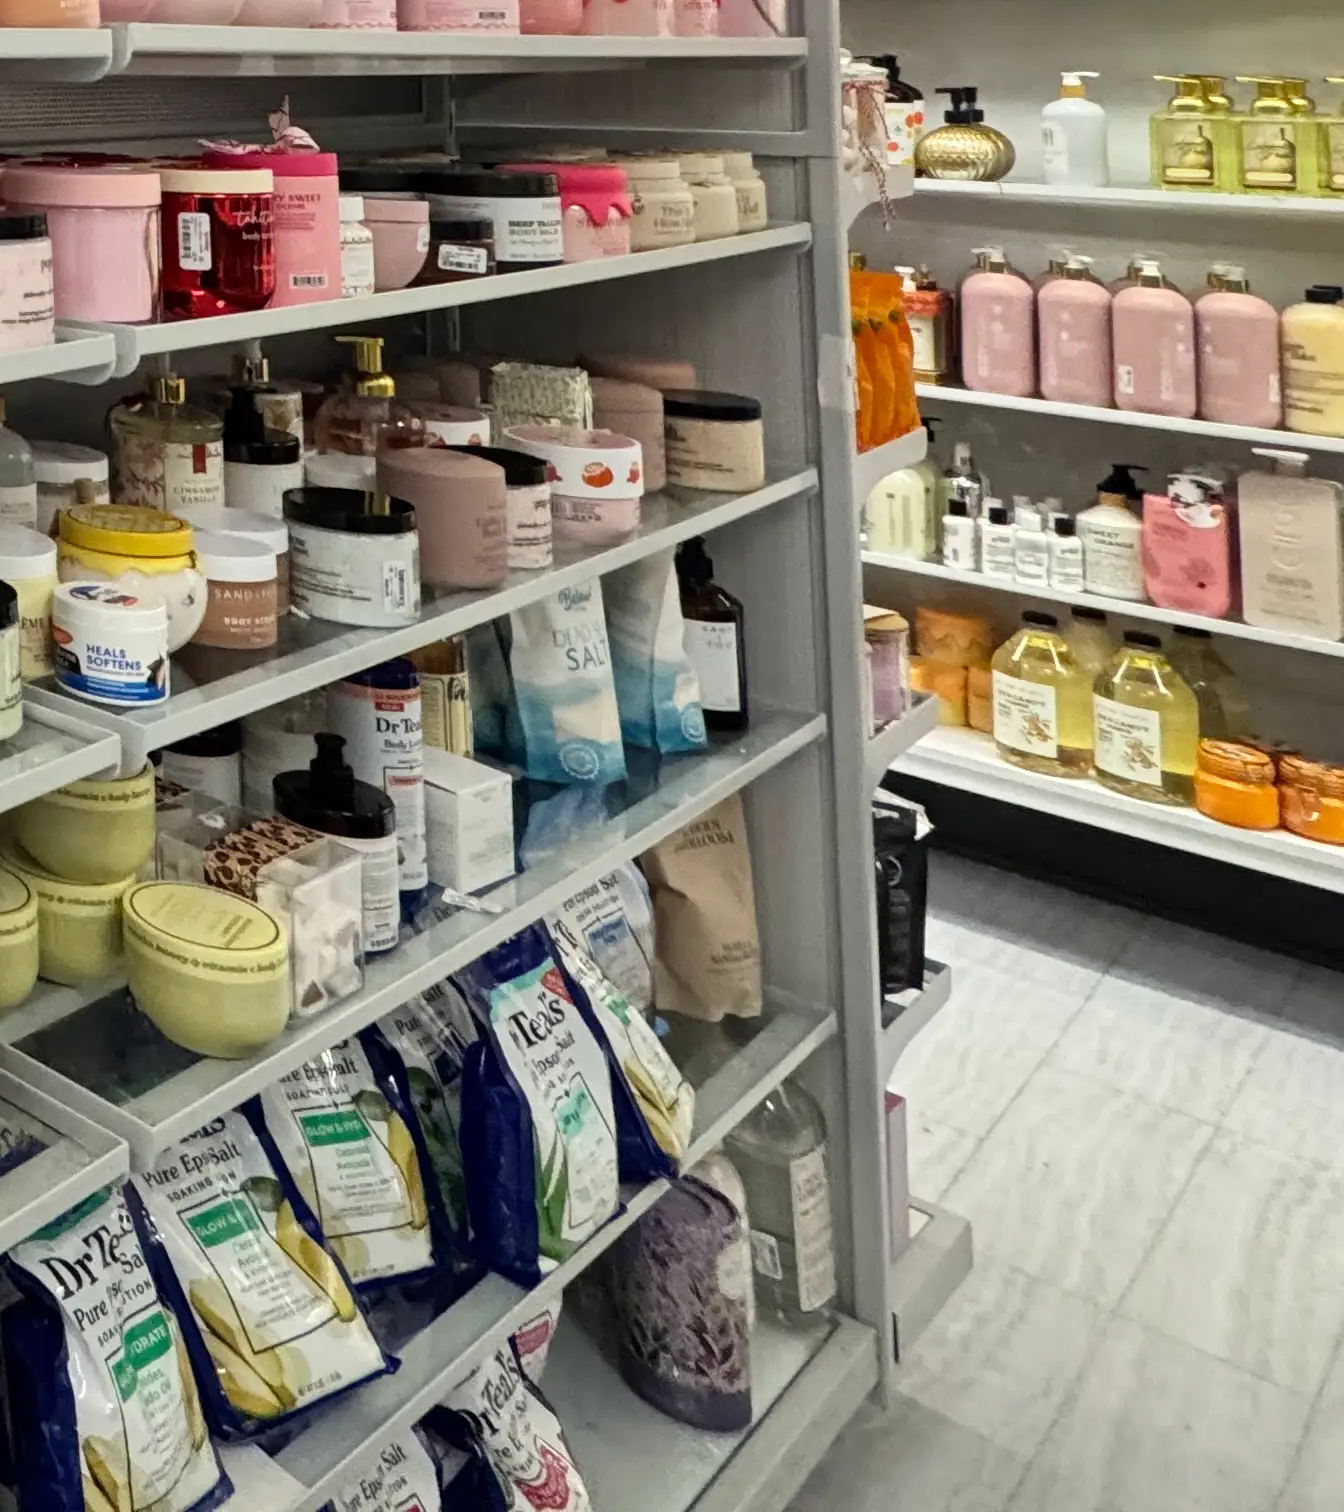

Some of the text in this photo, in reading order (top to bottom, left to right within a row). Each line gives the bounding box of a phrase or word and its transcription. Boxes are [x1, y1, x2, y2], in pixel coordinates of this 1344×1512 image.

[85, 642, 127, 661] HEALS
[85, 654, 143, 673] SOFTENS
[564, 638, 611, 672] SALT
[375, 716, 401, 734] Dr
[141, 1140, 243, 1190] Pure Salt
[72, 1299, 109, 1333] Pure
[378, 1443, 408, 1473] Salt
